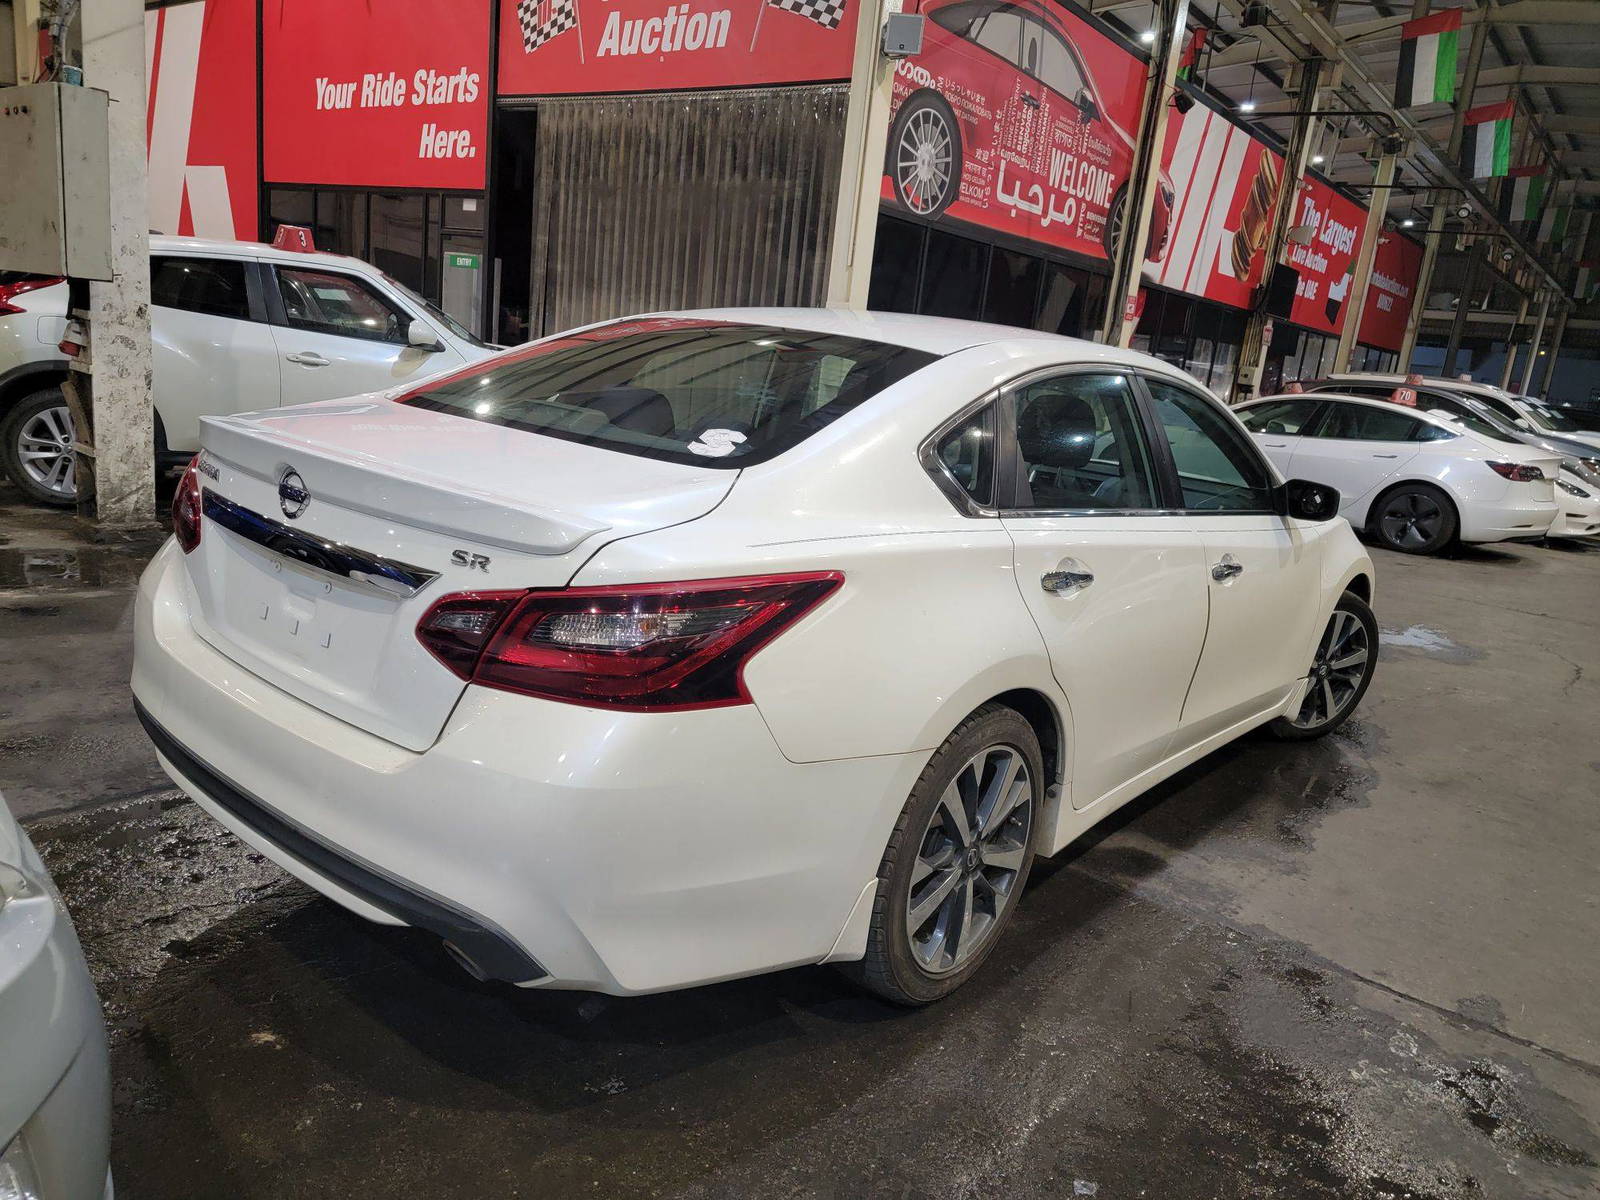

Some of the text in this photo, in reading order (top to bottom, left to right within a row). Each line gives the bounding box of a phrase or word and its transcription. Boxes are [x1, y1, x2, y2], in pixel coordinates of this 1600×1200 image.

[596, 4, 732, 57] Auction
[315, 67, 480, 110] Your Ride Starts
[419, 124, 476, 159] Here.
[1034, 103, 1049, 174] WILLKOMMEN
[997, 159, 1077, 228] مرحبا
[1048, 147, 1115, 209] WELCOME
[298, 230, 308, 248] 3
[1300, 196, 1358, 256] The Largest
[1400, 391, 1411, 401] 70
[450, 549, 491, 573] SR
